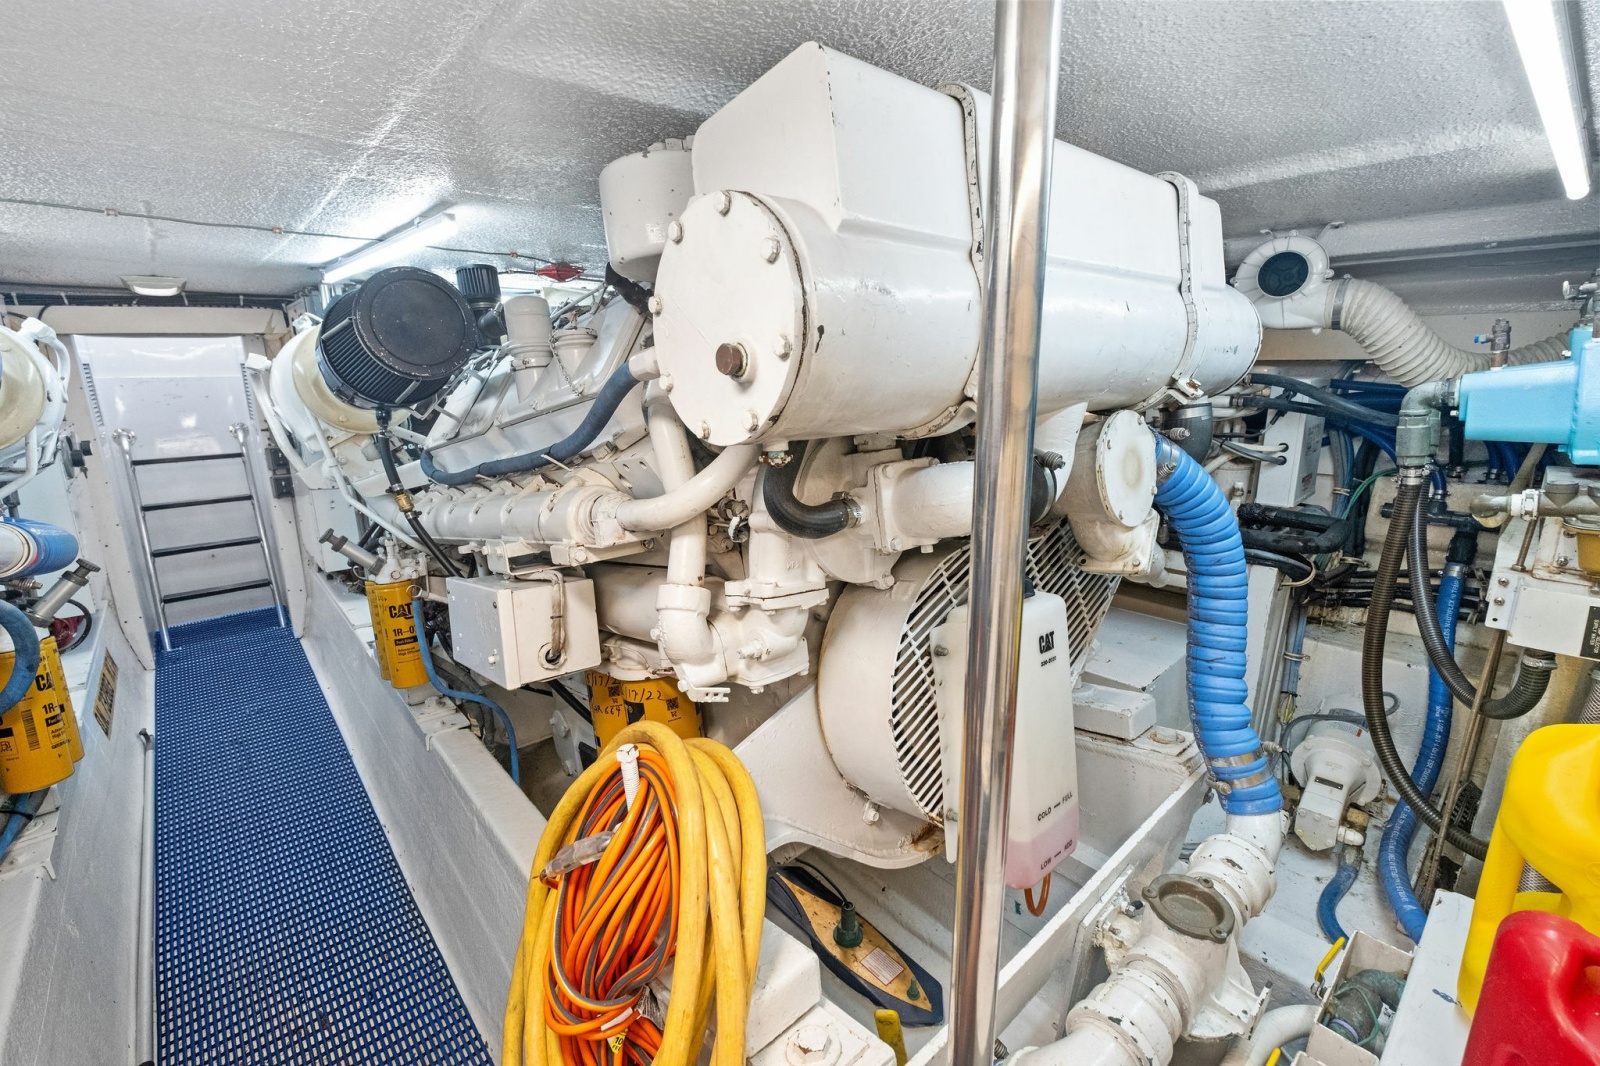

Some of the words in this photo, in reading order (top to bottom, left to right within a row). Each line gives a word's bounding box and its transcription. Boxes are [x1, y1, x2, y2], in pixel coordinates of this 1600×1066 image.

[389, 603, 414, 619] CAT
[393, 625, 416, 637] 1R-0
[1039, 631, 1054, 654] CAT
[35, 672, 53, 691] CA
[42, 703, 57, 714] 1R-
[1037, 807, 1052, 821] COLD
[1062, 791, 1073, 803] FULL
[1041, 857, 1052, 870] LOW
[1064, 839, 1073, 851] ADD
